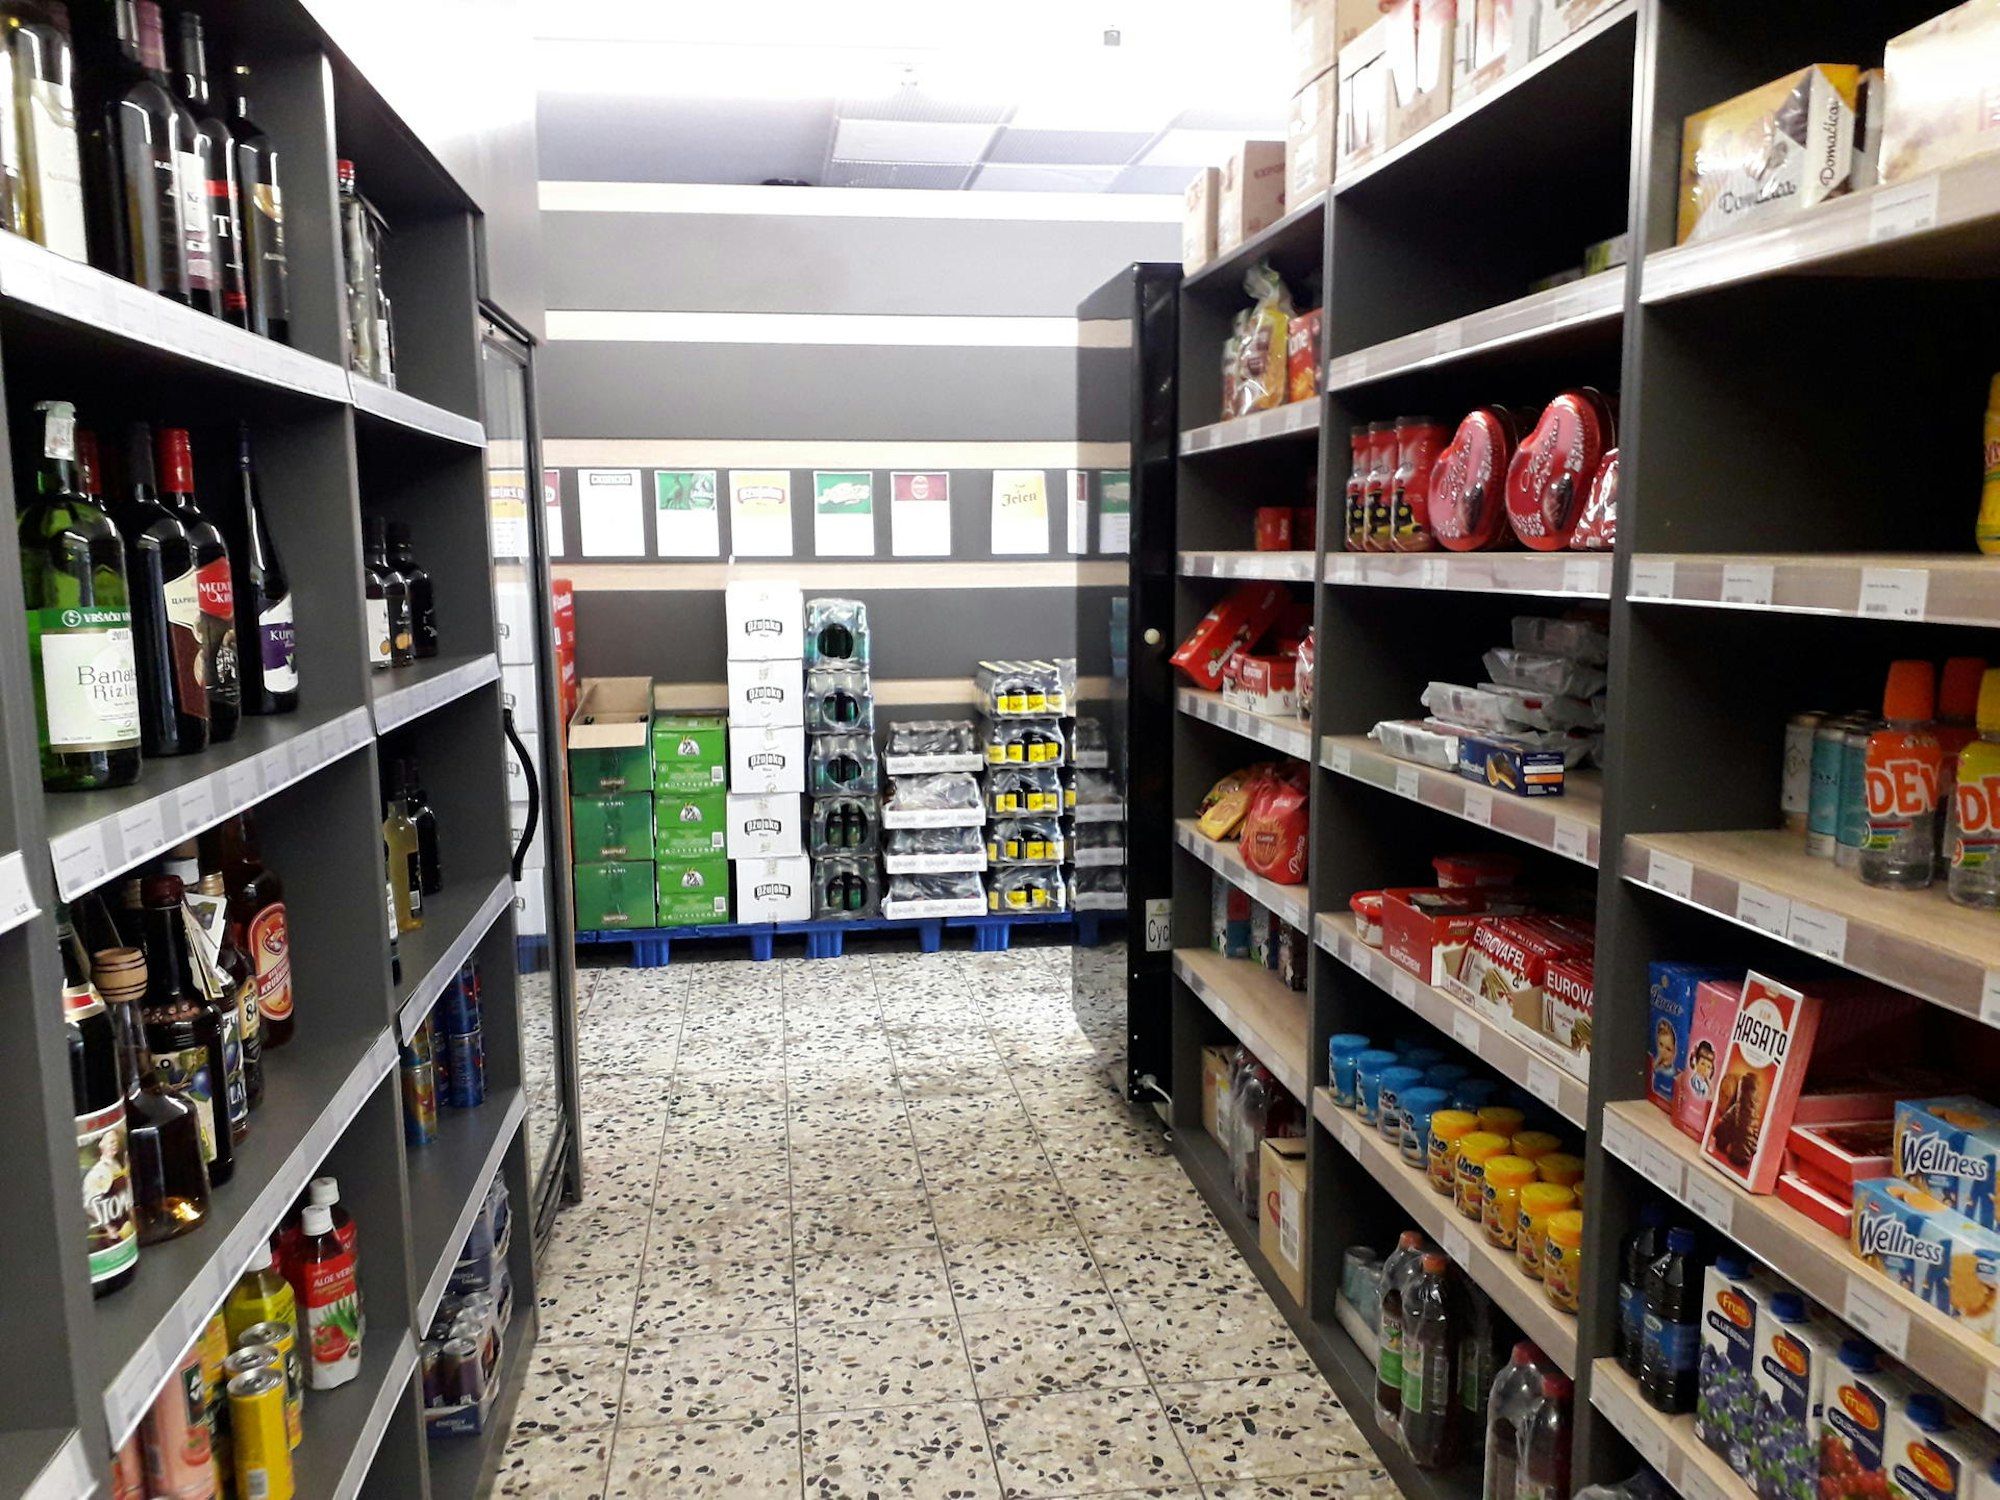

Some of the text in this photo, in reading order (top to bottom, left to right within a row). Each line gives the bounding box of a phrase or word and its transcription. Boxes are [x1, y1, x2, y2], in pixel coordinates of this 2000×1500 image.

[1473, 926, 1526, 973] EUROVAFEL
[1901, 1131, 1987, 1179] Wellness
[1858, 1212, 1943, 1263] Wellness
[313, 1272, 336, 1288] ALOE
